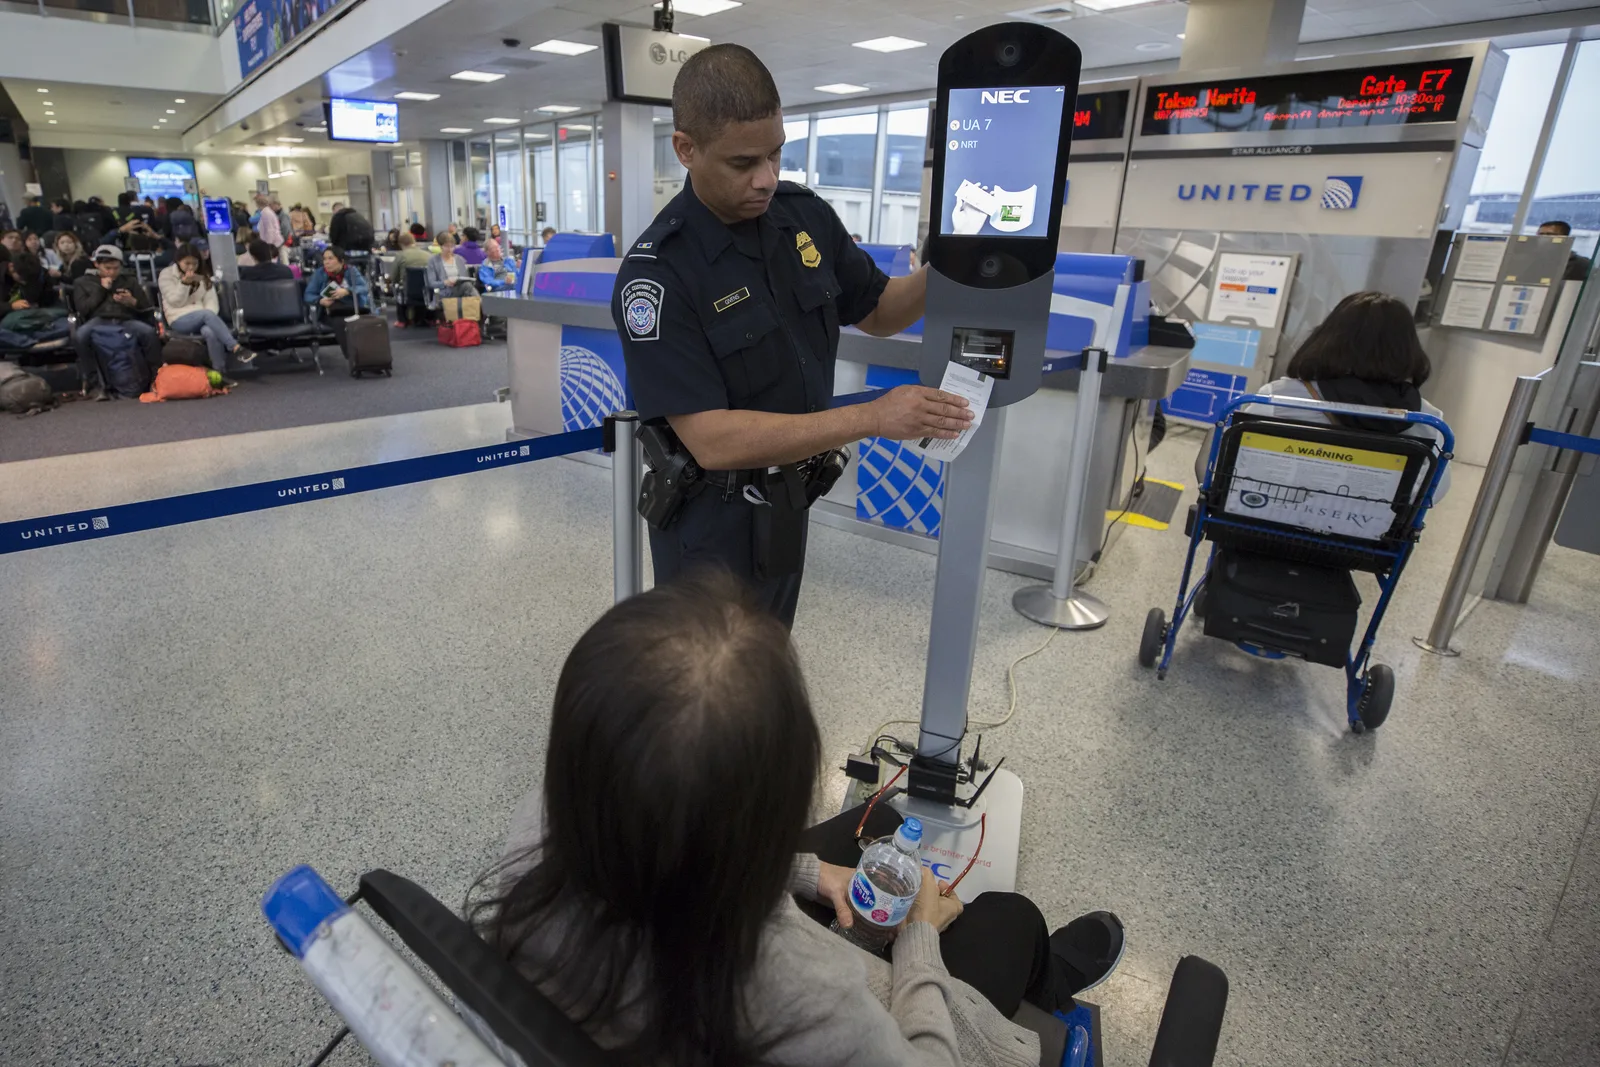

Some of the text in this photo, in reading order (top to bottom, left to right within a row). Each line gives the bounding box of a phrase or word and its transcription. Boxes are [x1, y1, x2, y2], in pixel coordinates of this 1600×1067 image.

[1360, 69, 1453, 96] Gate E7
[981, 90, 1030, 104] NEC
[1157, 87, 1257, 109] Tokyo Narita
[1337, 96, 1389, 109] Departs
[962, 119, 992, 131] UA 7
[961, 141, 978, 149] NRT
[1232, 145, 1301, 155] STAR ALLIANCE
[1178, 184, 1312, 202] UNITED
[636, 291, 659, 306] PROTECTION
[477, 450, 518, 463] UNITED
[1298, 446, 1354, 462] WARNING
[278, 483, 330, 497] UNITED
[20, 522, 89, 539] UNITED
[930, 844, 964, 860] brighter
